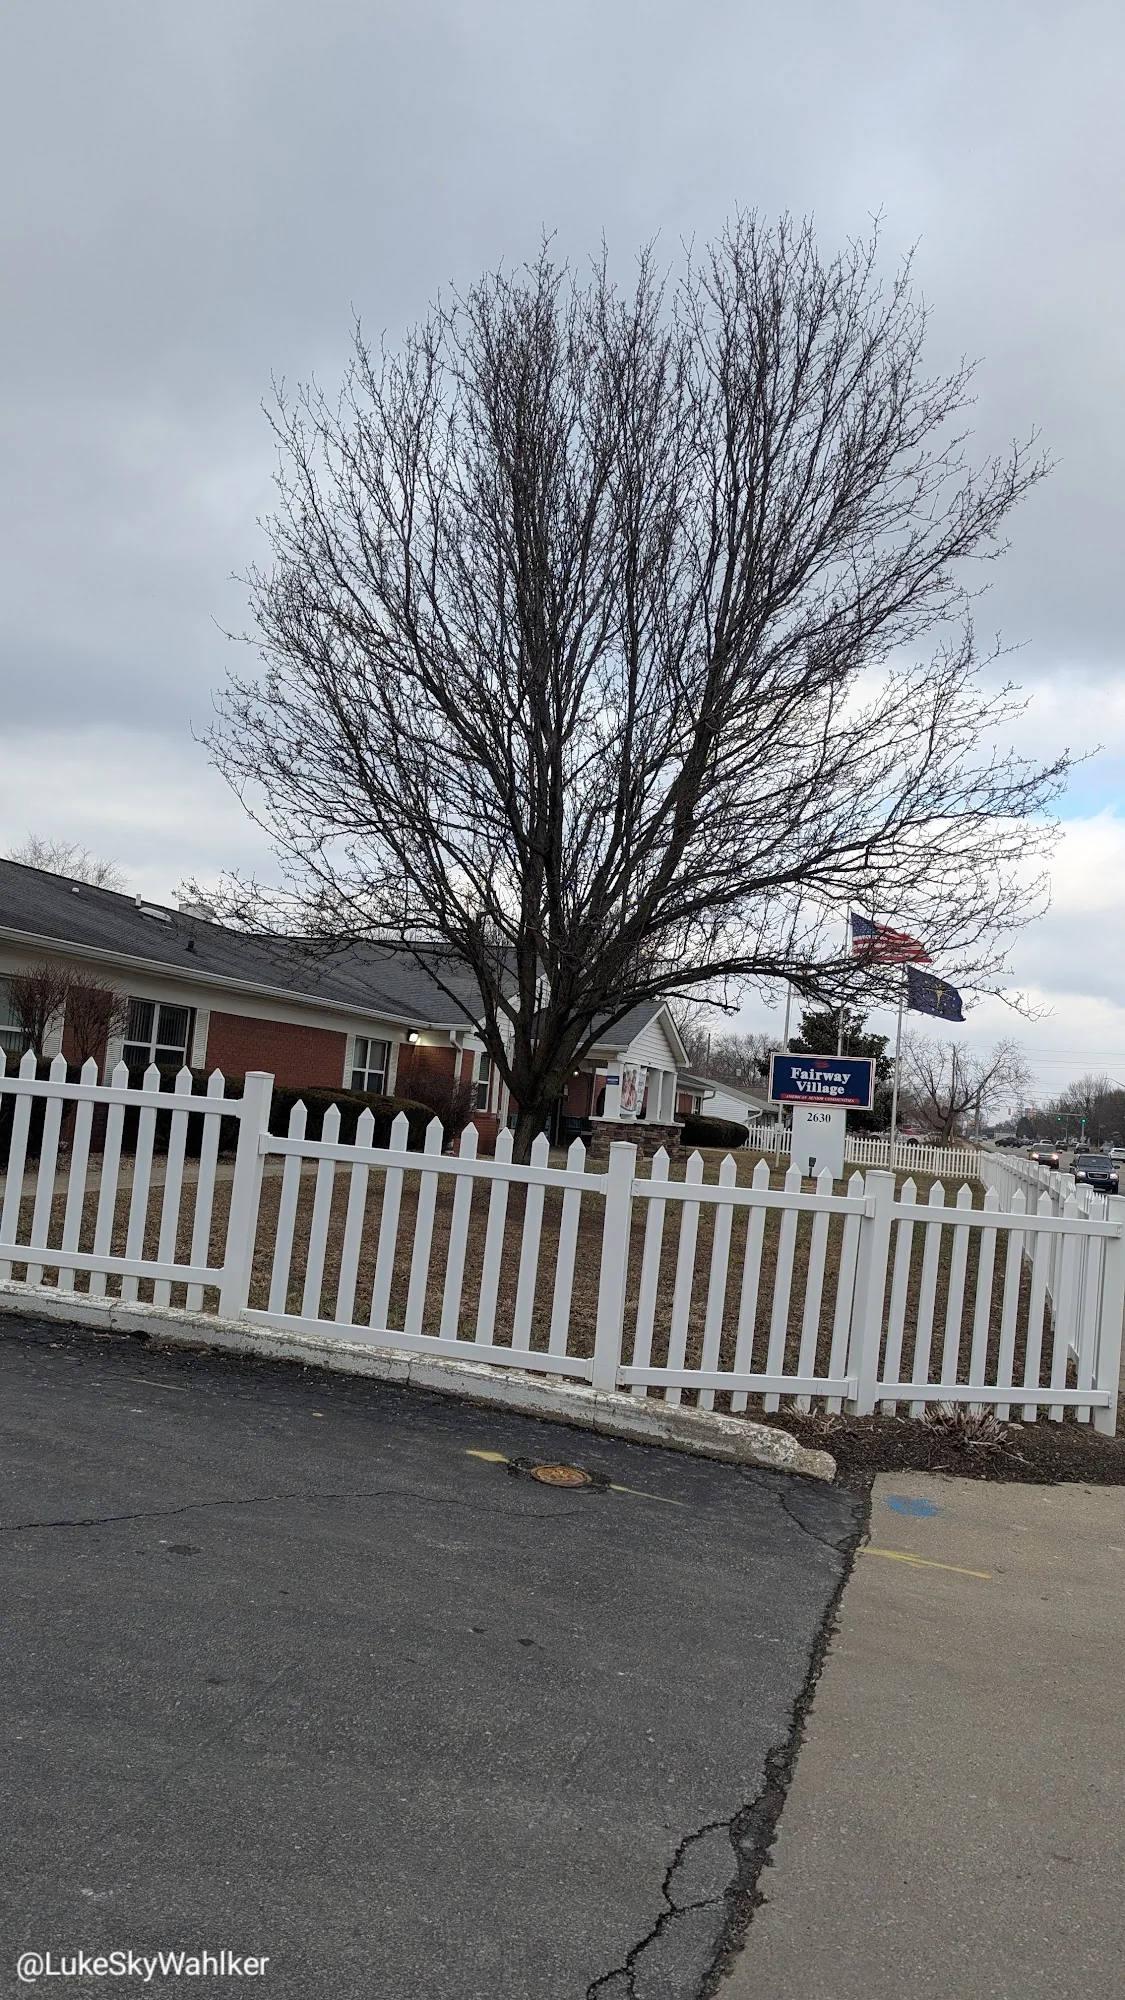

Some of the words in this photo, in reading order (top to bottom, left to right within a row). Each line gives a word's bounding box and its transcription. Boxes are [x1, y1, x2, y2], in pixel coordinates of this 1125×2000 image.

[790, 1067, 851, 1084] Fairway
[796, 1081, 845, 1096] Village
[807, 1112, 831, 1123] 2630
